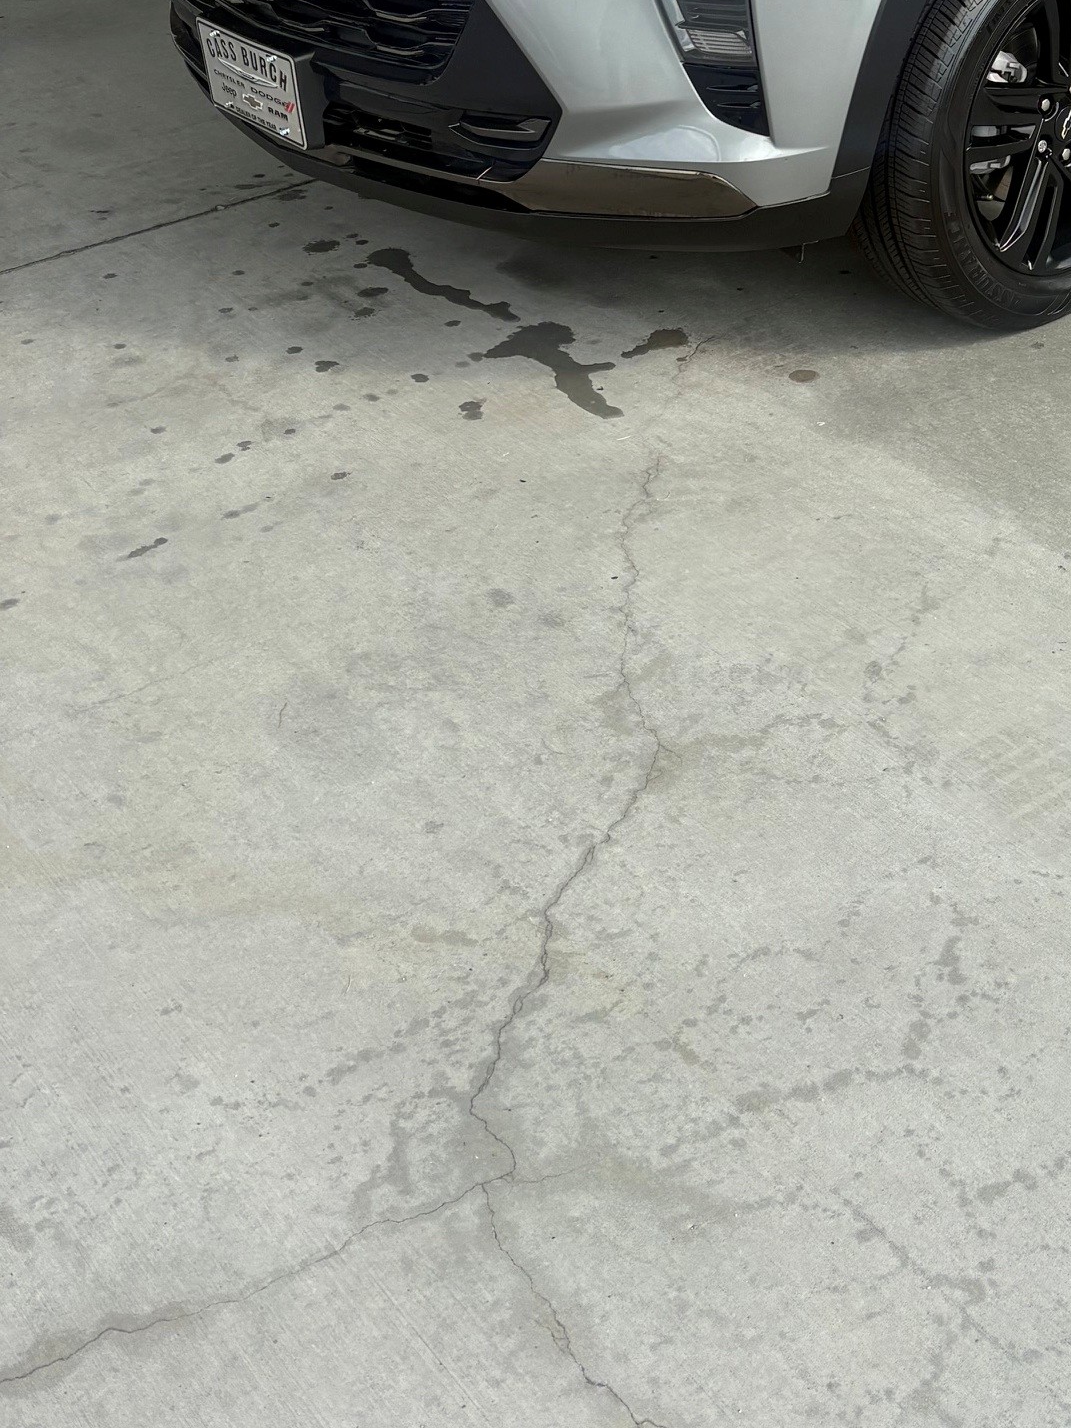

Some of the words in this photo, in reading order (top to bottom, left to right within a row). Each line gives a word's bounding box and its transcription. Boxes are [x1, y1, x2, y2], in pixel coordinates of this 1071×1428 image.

[206, 37, 237, 62] CASS
[241, 46, 288, 92] BURCH
[214, 69, 246, 88] CHRYSLER
[222, 82, 237, 98] Jeep
[267, 106, 289, 122] RAM
